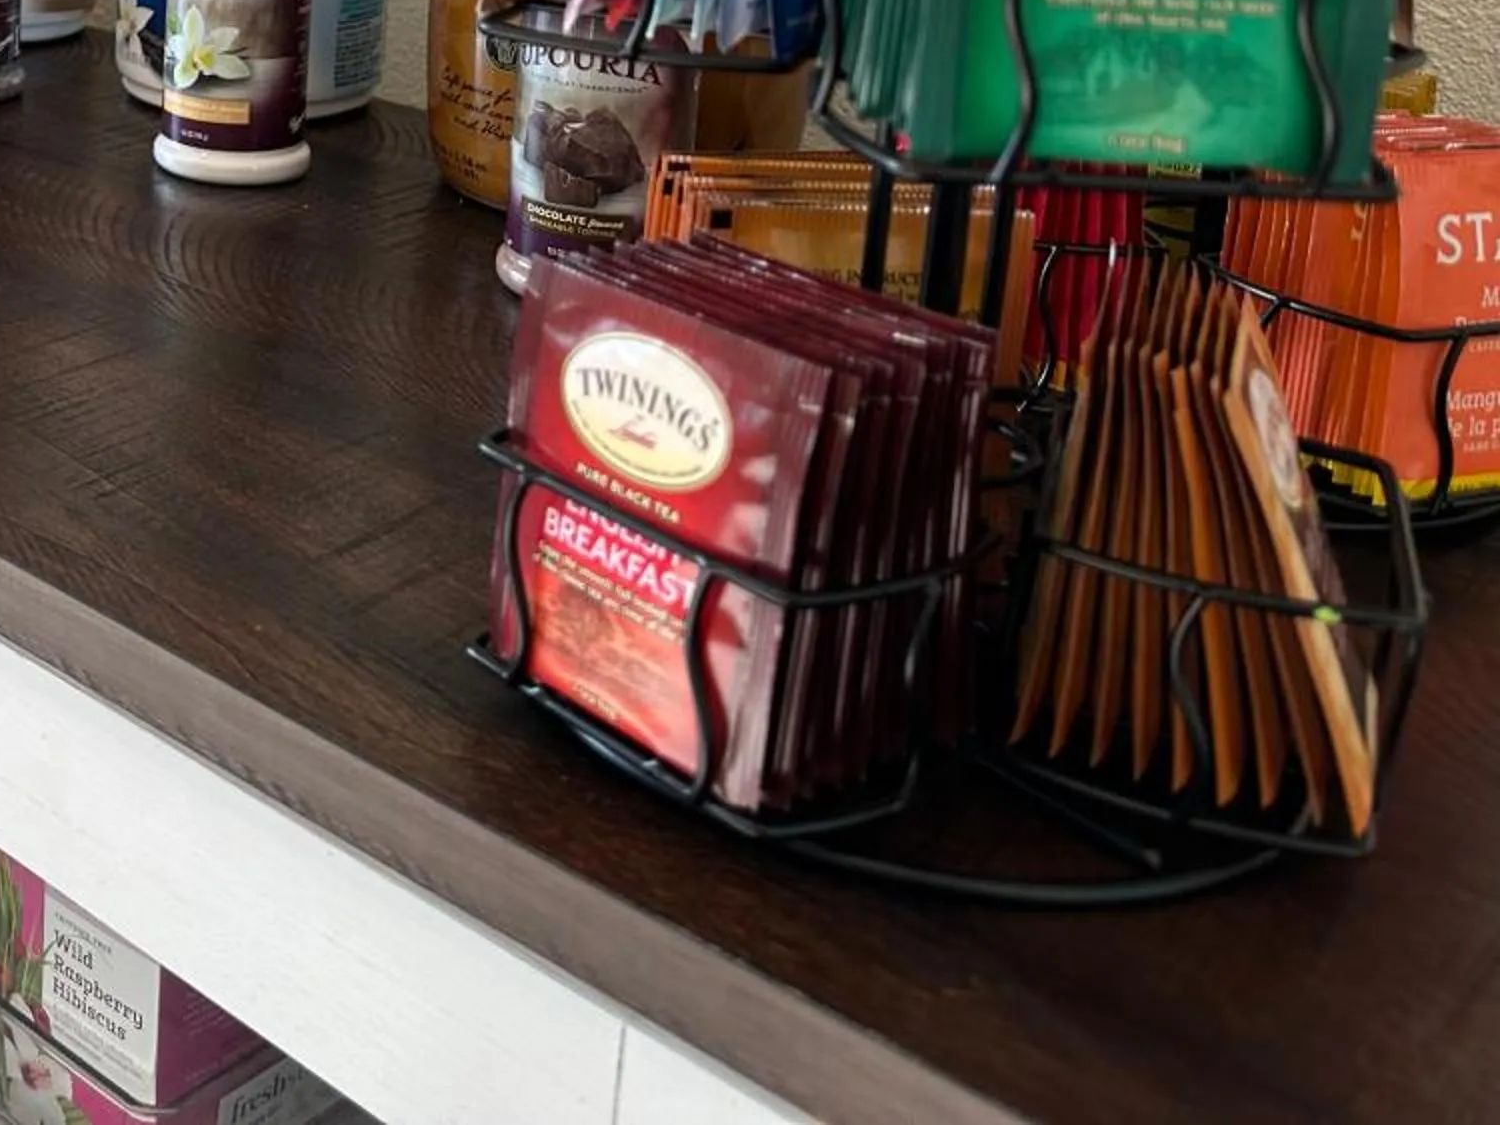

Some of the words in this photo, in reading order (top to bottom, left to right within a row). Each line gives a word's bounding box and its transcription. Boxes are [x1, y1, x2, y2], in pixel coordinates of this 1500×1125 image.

[576, 367, 717, 452] TWININGS
[575, 461, 609, 488] PURE
[609, 479, 651, 512] BLACK
[653, 500, 681, 524] TEA
[543, 506, 696, 610] BREAKFAST
[53, 929, 94, 971] Wild
[52, 953, 144, 1030] Raspberry
[52, 976, 127, 1042] Hibiscus
